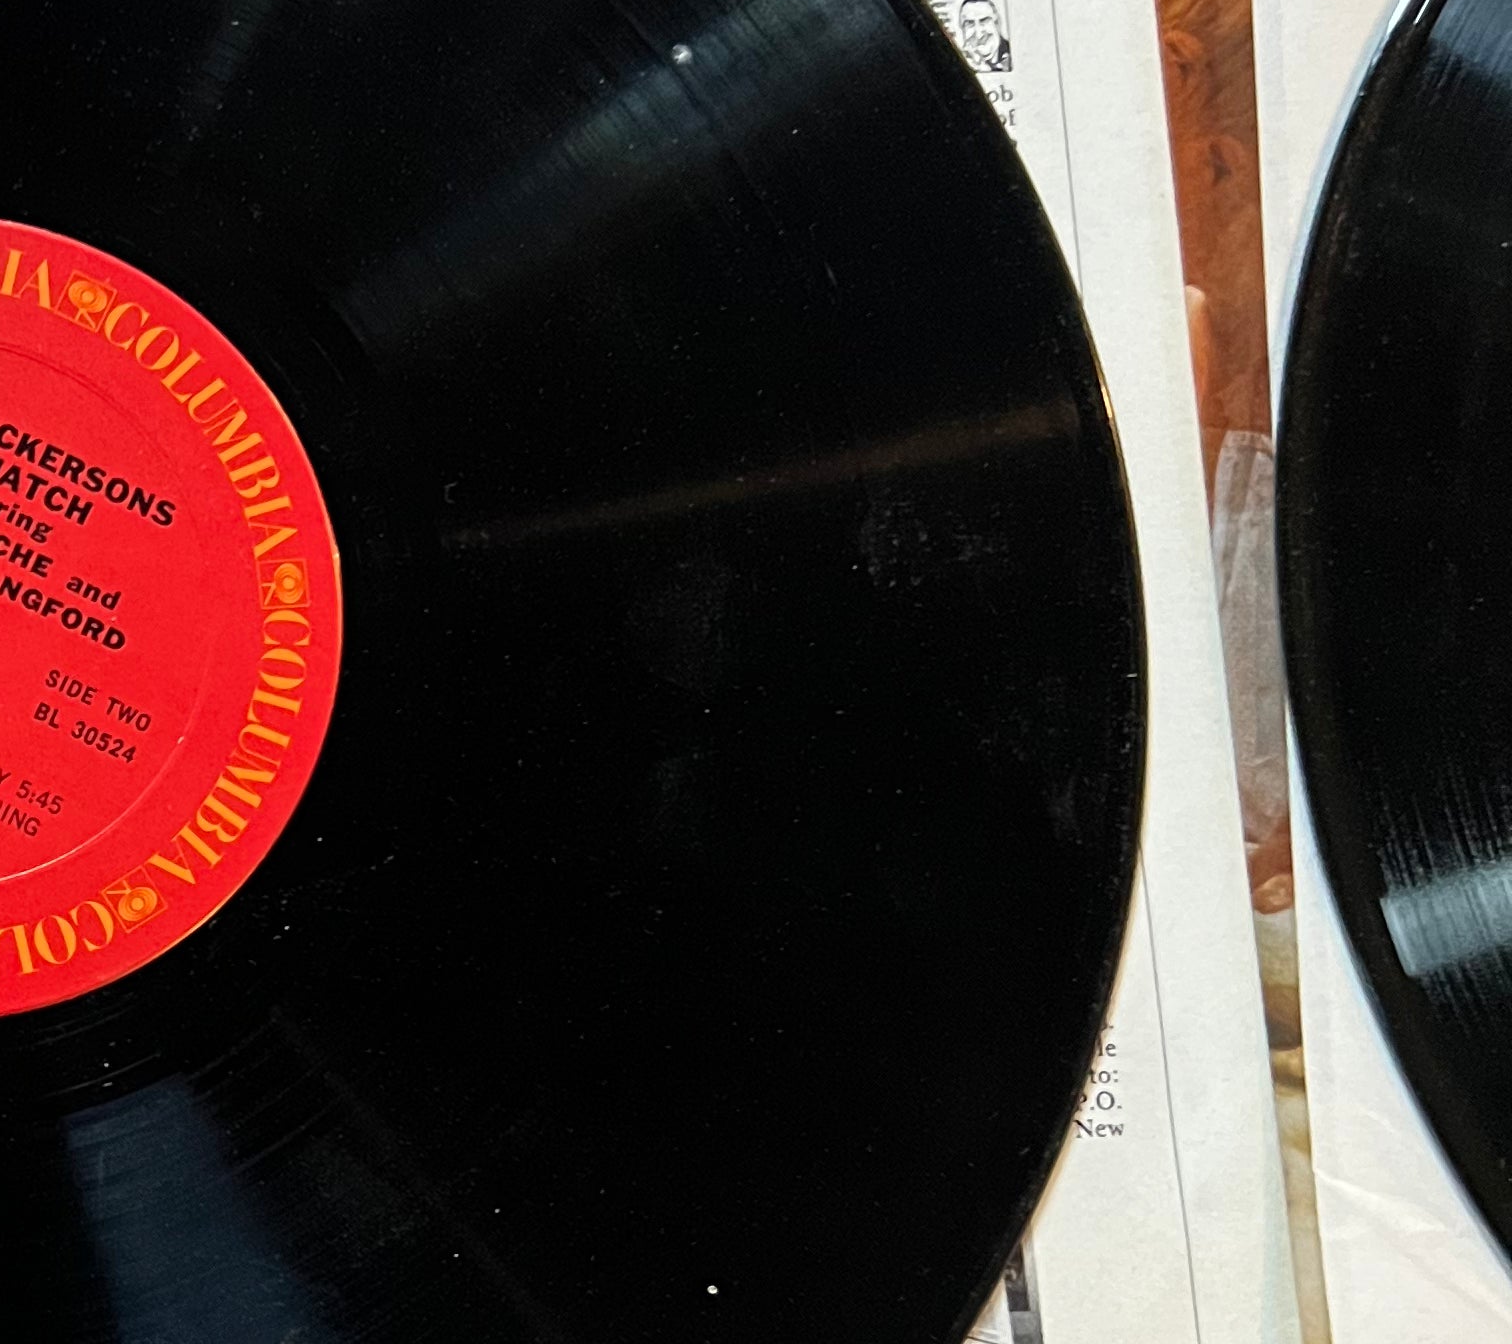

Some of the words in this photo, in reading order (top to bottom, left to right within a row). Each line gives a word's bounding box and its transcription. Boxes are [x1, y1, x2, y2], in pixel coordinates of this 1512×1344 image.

[102, 299, 298, 565] COLUMBIA
[66, 570, 122, 611] and
[45, 668, 99, 707] SIDE
[106, 695, 152, 732] TWO
[33, 702, 60, 729] BL
[70, 720, 137, 765] 30524
[148, 610, 311, 904] COLUMBIA
[14, 781, 63, 816] 5:45
[1073, 1118, 1124, 1138] New
